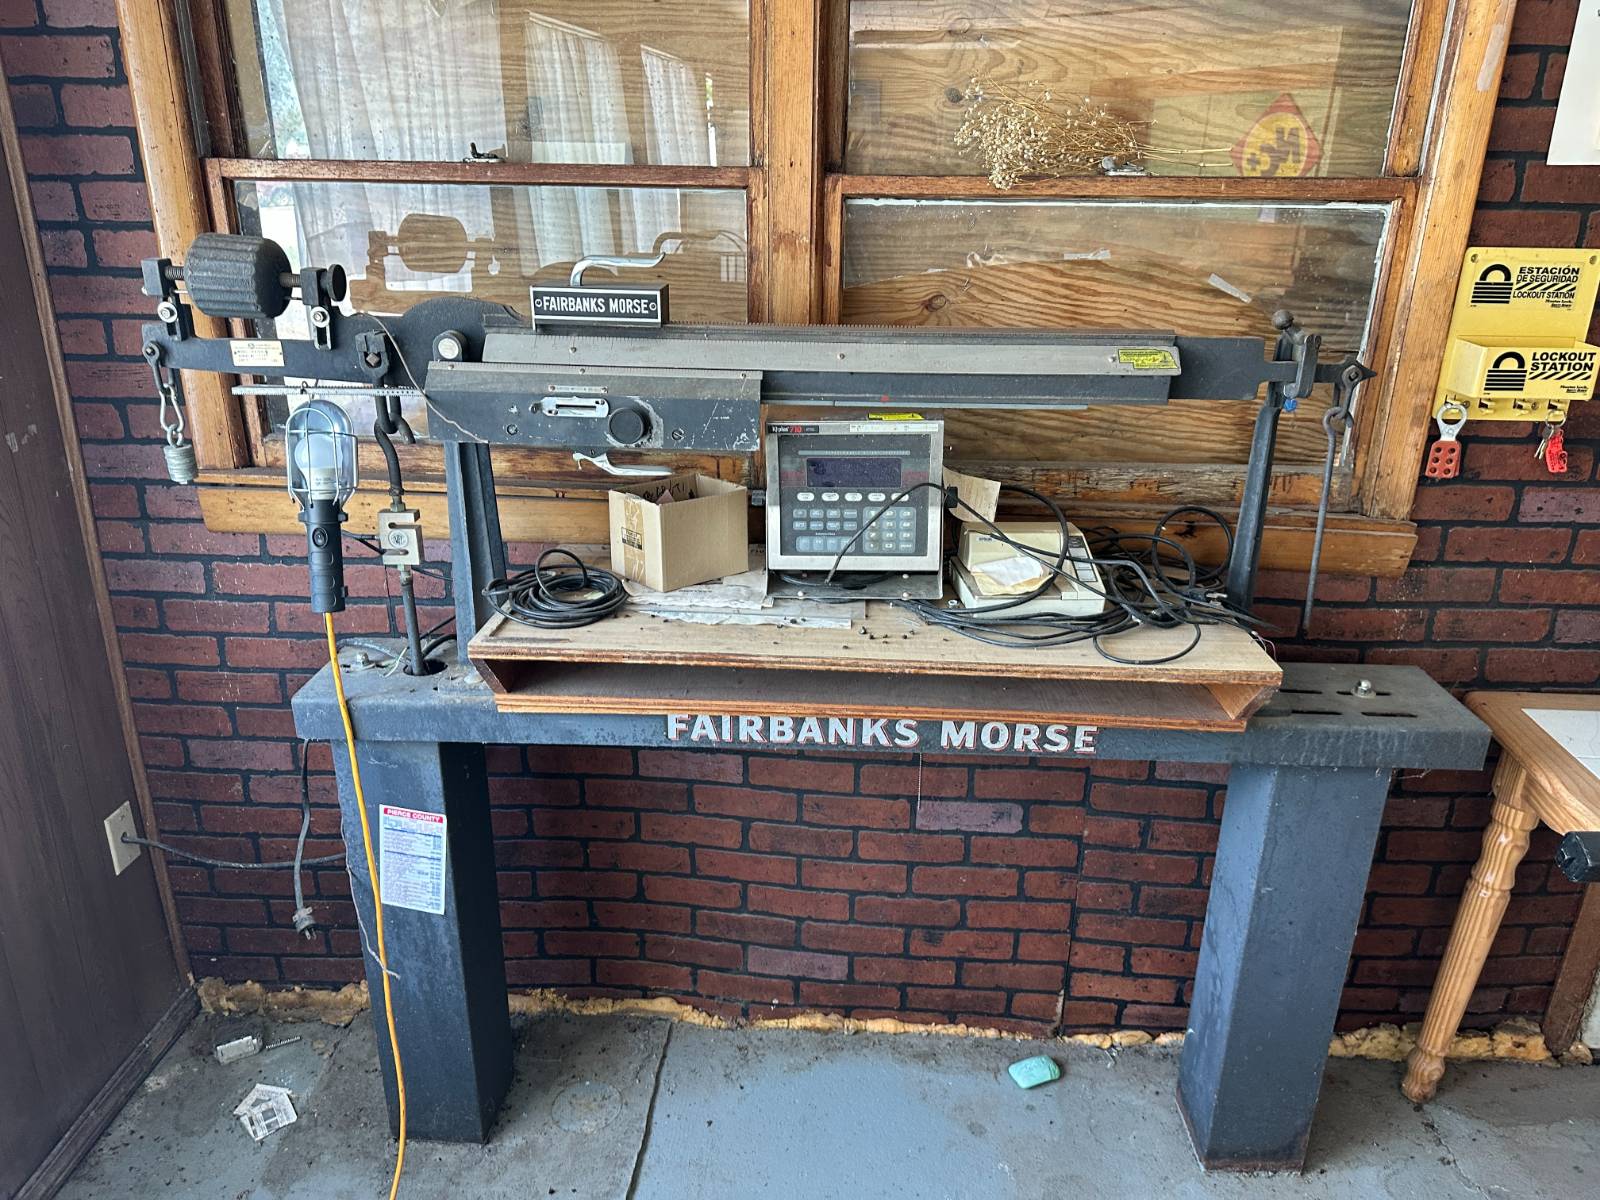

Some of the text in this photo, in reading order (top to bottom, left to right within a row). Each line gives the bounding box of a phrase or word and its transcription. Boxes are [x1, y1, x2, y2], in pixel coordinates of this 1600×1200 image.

[1519, 265, 1580, 275] ESTACIÓN
[1516, 274, 1578, 283] DE SEGURIDAD
[1513, 291, 1575, 299] LOCKOUT STATION
[542, 296, 649, 314] FAIRBANKS MORSE
[1532, 352, 1597, 361] LOCKOUT
[1530, 362, 1594, 371] STATION
[667, 714, 1099, 754] FAIRBANKS MORSE
[387, 809, 441, 823] PIERCE COUNTY
